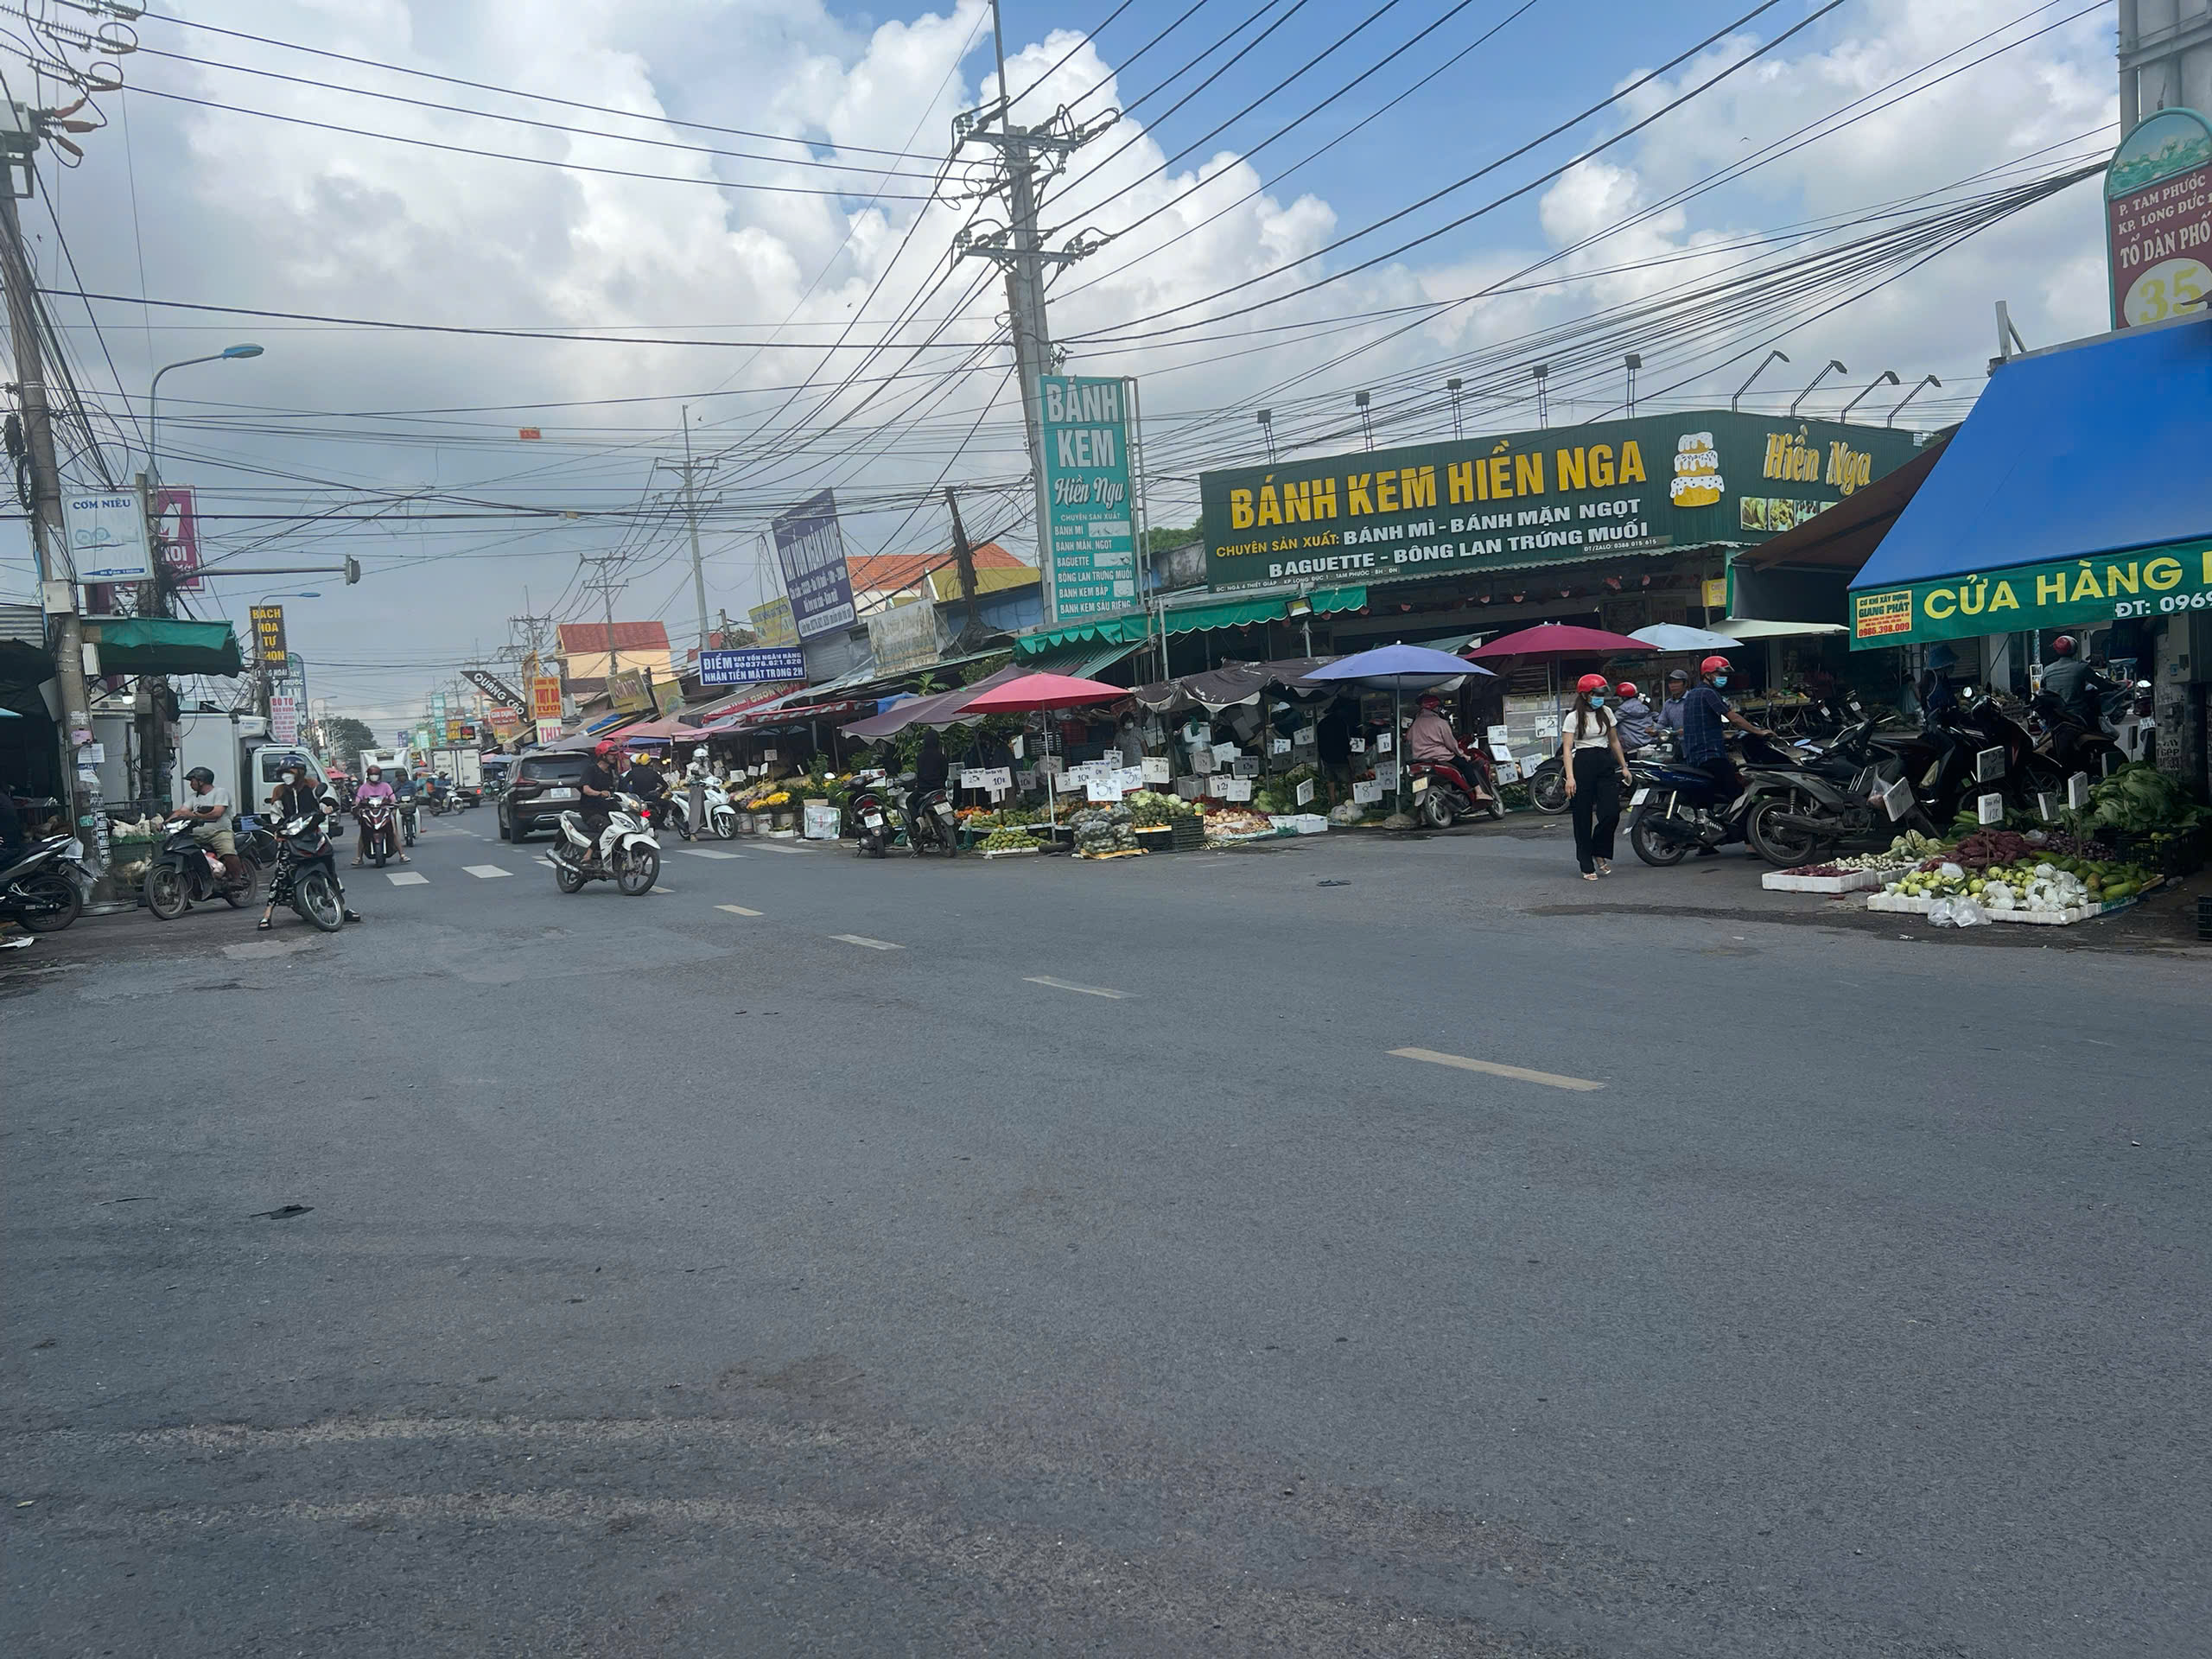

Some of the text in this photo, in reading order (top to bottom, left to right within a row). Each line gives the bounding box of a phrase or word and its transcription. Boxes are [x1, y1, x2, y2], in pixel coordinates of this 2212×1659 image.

[2119, 173, 2206, 216] P. TAM PHƯỚC
[2118, 220, 2136, 235] KP.
[2140, 206, 2175, 226] LONG
[2177, 191, 2204, 213] ĐỨC
[2144, 228, 2176, 262] DÂN
[2179, 211, 2211, 250] PHỐ
[2140, 266, 2201, 323] 35
[1046, 375, 1119, 423] BÁNH
[1056, 429, 1116, 467] KEM
[1763, 424, 1872, 496] Hiền Nga
[1054, 474, 1125, 510] Hiền Nga
[1230, 440, 1647, 531] BÁNH KEM HIỀN NGA
[73, 498, 130, 510] CƠM NIÊU
[1104, 512, 1121, 520] XUẤT
[1216, 540, 1268, 558] CHUYÊN
[1271, 536, 1298, 552] SẢN
[1302, 530, 1339, 548] XUẤT:
[1344, 525, 1403, 546] BÁNH
[1408, 519, 1436, 538] MÌ
[1451, 512, 1512, 533] BÁNH
[1517, 505, 1570, 527] MẶN
[1580, 498, 1641, 519] NGỌT
[1057, 556, 1090, 567] BAGUETTE
[1268, 552, 1376, 578] BAGUETTE
[1393, 544, 1453, 564] BÔNG
[1459, 538, 1502, 557] LAN
[1507, 531, 1583, 551] TRỨNG
[1587, 518, 1648, 543] MUỐI
[1077, 572, 1090, 582] LAN
[1116, 568, 1133, 579] MUỐI
[1349, 569, 1370, 577] PHƯỚC
[1923, 556, 2183, 620] CỬA HÀNG
[1078, 587, 1093, 597] KEM
[1080, 601, 1095, 612] KEM
[1859, 606, 1885, 618] GIANG
[2115, 599, 2151, 618] ĐT:
[703, 652, 732, 670] ĐIỂM
[704, 672, 728, 687] NHẬN
[748, 669, 765, 681] MẶT
[766, 668, 791, 678] TRONG
[792, 666, 804, 677] 2H
[474, 672, 507, 701] QUẢNG
